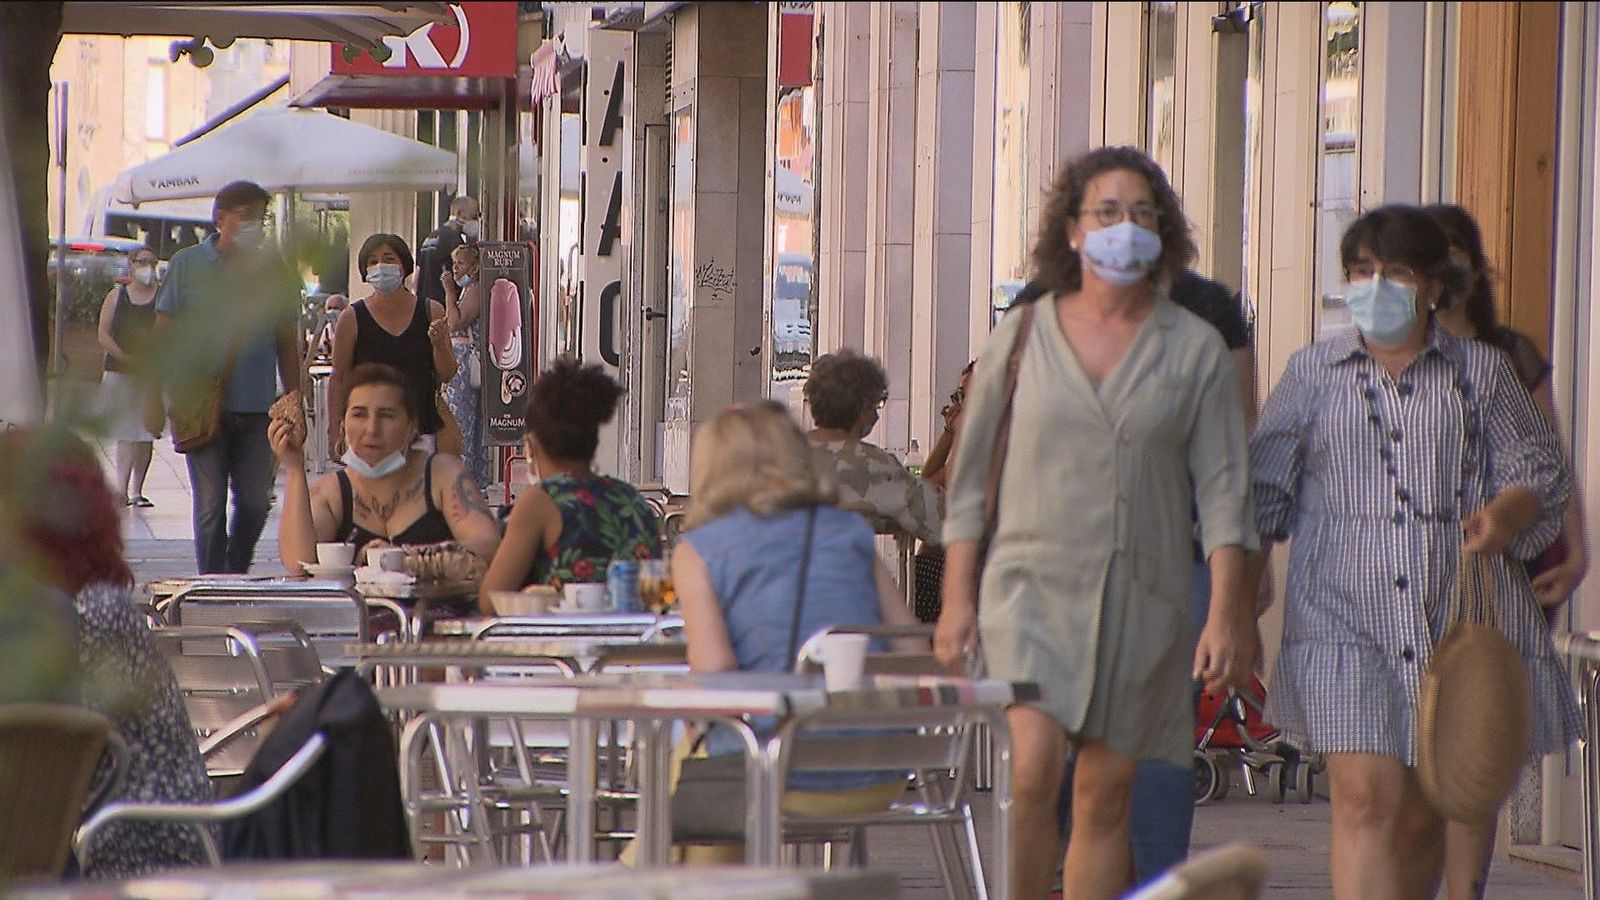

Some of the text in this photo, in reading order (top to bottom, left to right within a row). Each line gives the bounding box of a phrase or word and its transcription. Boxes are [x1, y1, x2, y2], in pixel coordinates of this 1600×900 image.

[157, 176, 200, 189] AMBAR
[487, 250, 521, 259] MAGNUM
[494, 258, 514, 267] RUBY
[490, 417, 526, 427] MAGNUM
